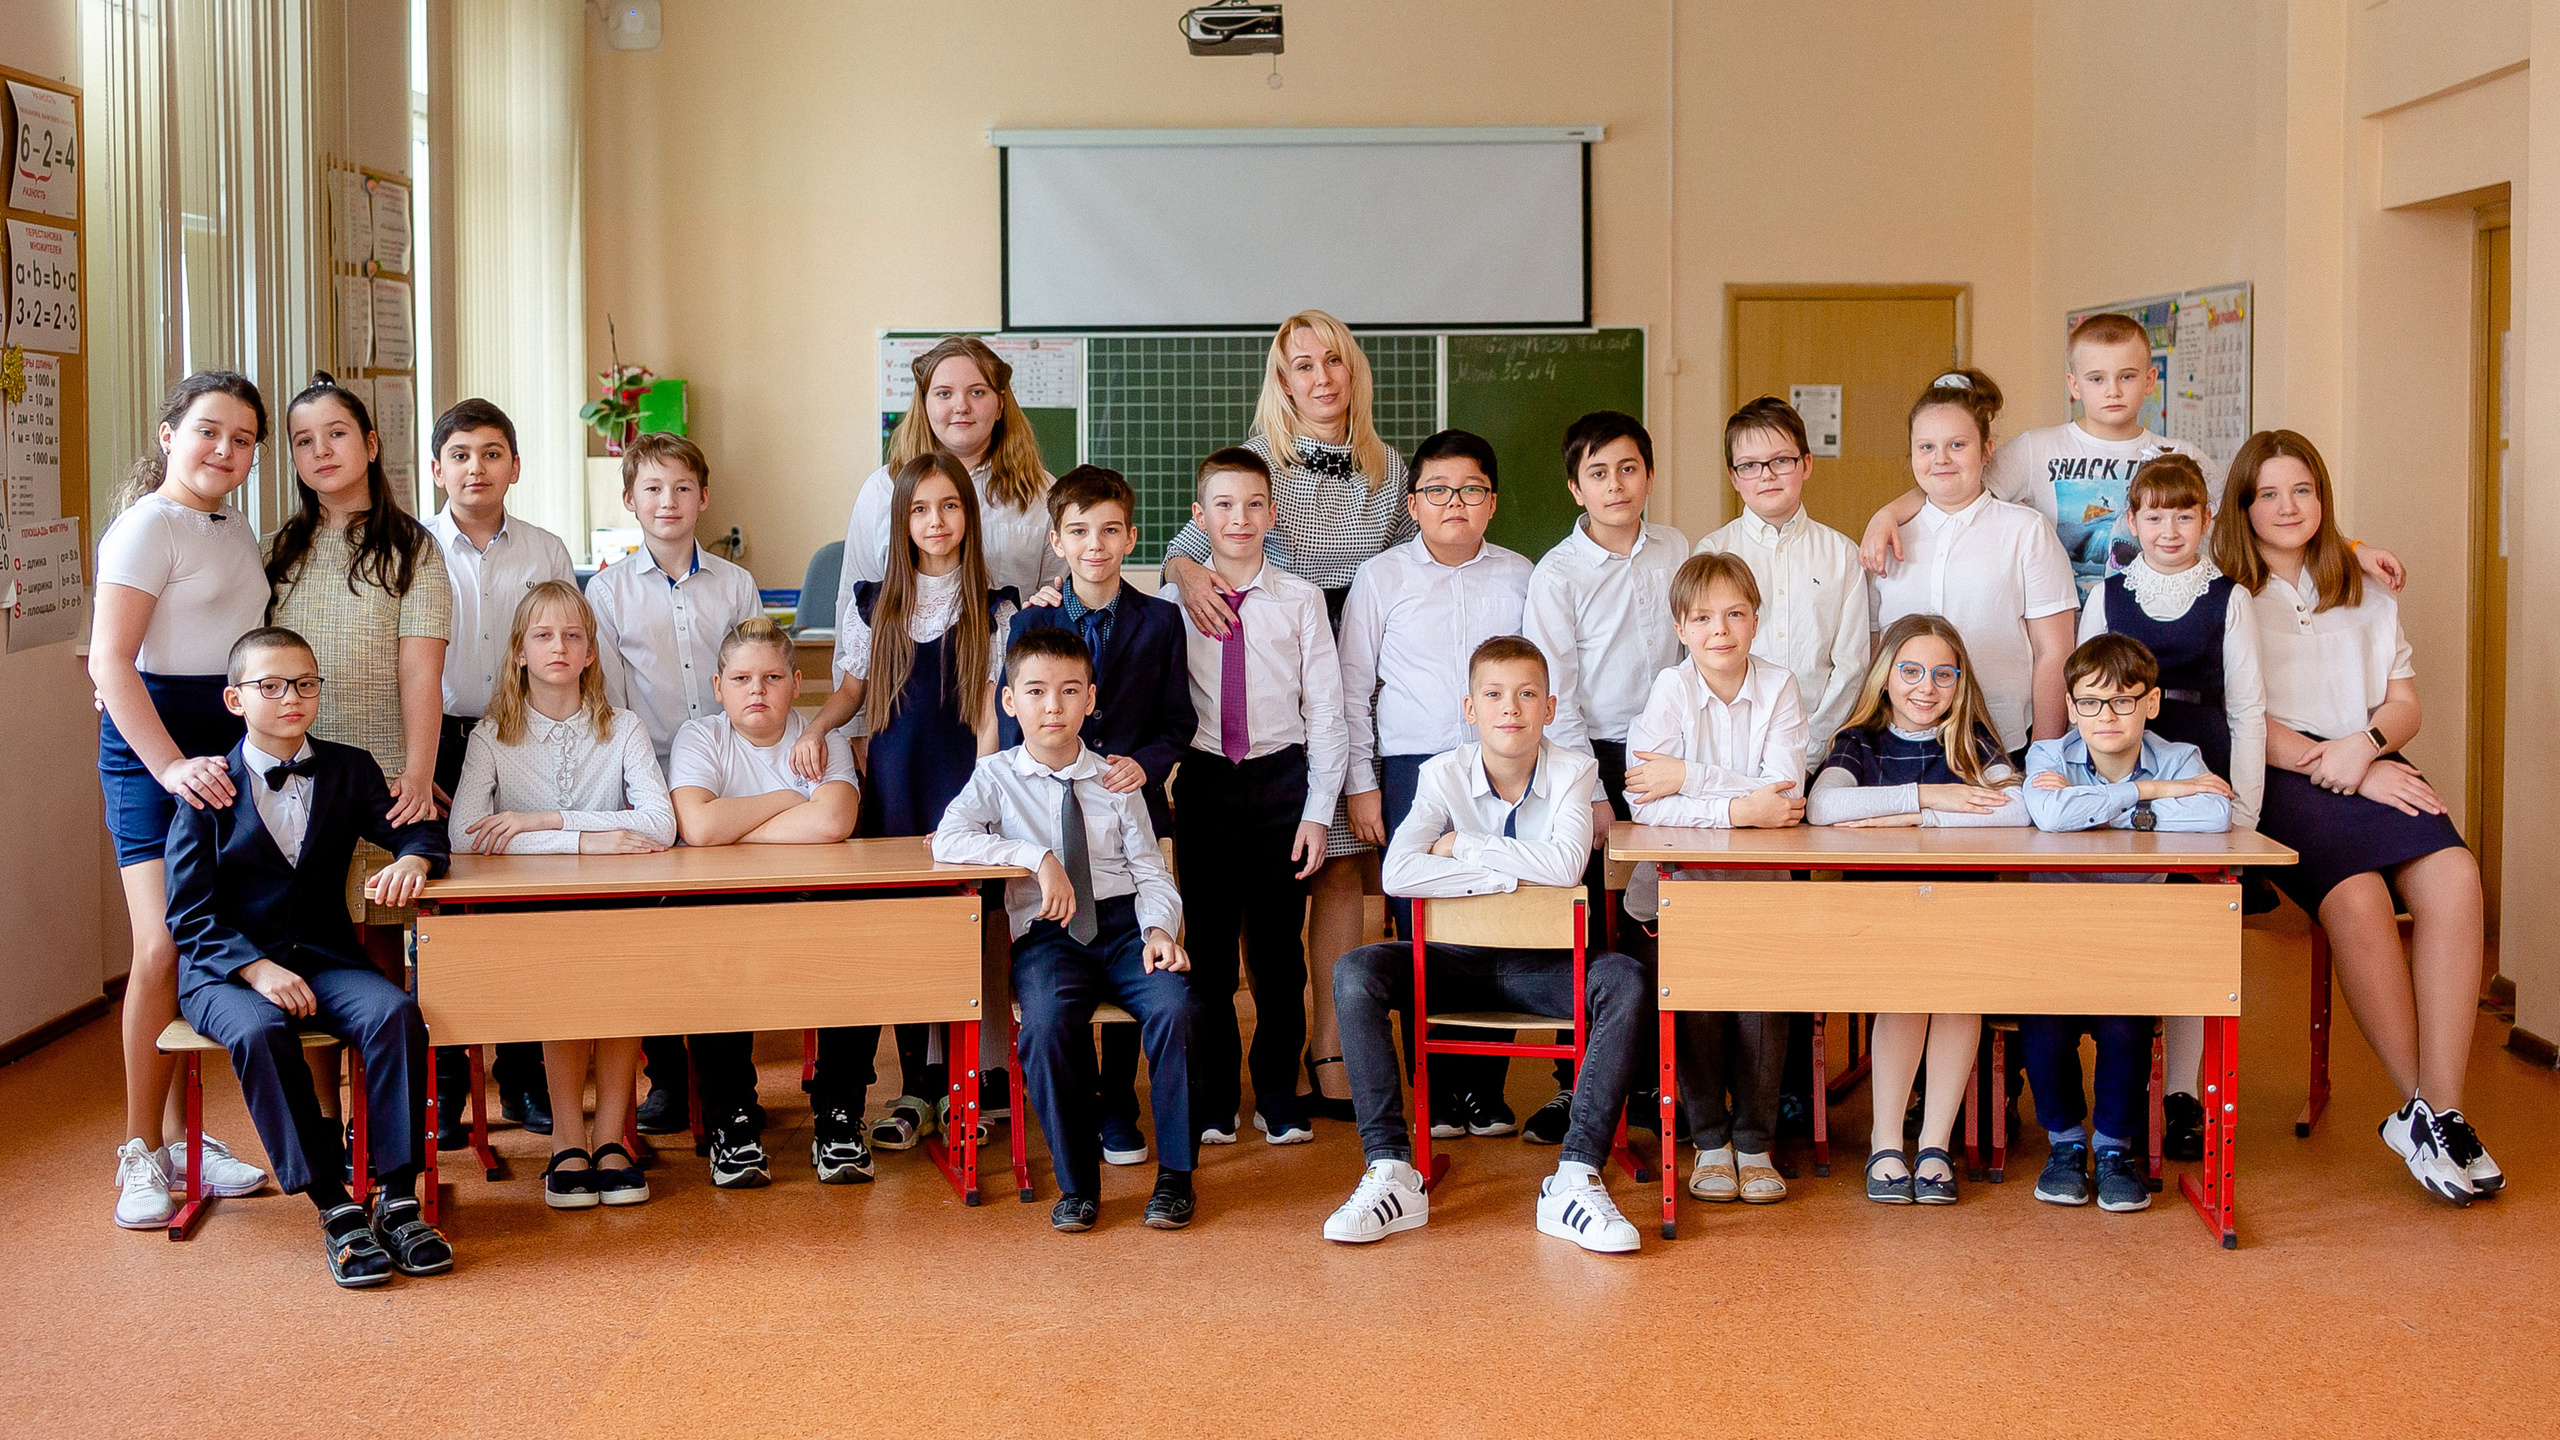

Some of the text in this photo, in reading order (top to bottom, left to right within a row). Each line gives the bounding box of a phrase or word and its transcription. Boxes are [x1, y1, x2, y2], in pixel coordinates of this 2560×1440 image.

[22, 187, 46, 200] РАЗНОСТЬ
[26, 227, 63, 242] ПЕРЕСТАНОВКА
[30, 241, 61, 254] МНОЖИТЕЛЕЙ
[35, 373, 50, 387] 1000
[35, 393, 43, 406] 10
[44, 396, 54, 408] дм
[11, 410, 15, 423] 1
[17, 413, 28, 426] дм
[36, 412, 44, 426] 10
[45, 416, 54, 426] см
[11, 430, 15, 443] 1
[32, 431, 43, 445] 100
[45, 436, 54, 446] см
[32, 452, 49, 465] 1000
[49, 455, 59, 466] мм
[2048, 457, 2120, 482] SNACK
[21, 523, 68, 538] ПЛОЩАДЬ ФИГУРЫ
[27, 557, 46, 571] длина
[28, 580, 52, 594] ширина
[27, 603, 56, 617] площадь
